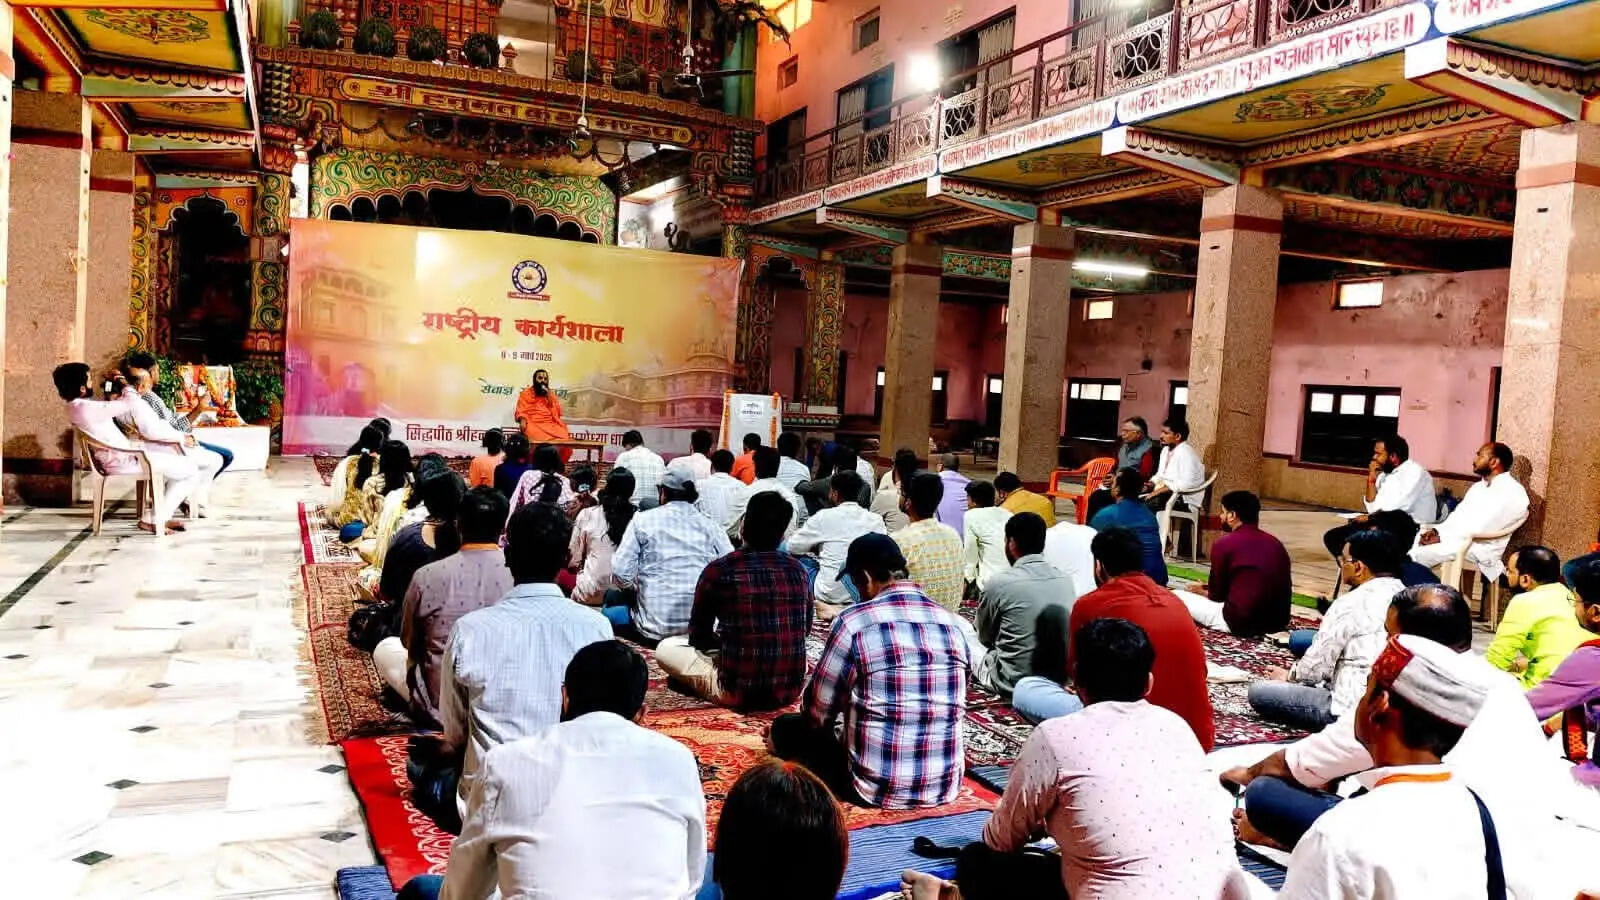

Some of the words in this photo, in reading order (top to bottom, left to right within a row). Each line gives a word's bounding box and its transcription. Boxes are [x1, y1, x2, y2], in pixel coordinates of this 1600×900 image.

[367, 84, 412, 105] श्री
[422, 307, 502, 340] राष्ट्रीय
[514, 315, 625, 343] कार्यशाला
[535, 352, 553, 362] 2026
[406, 423, 454, 442] सिद्धपीठ
